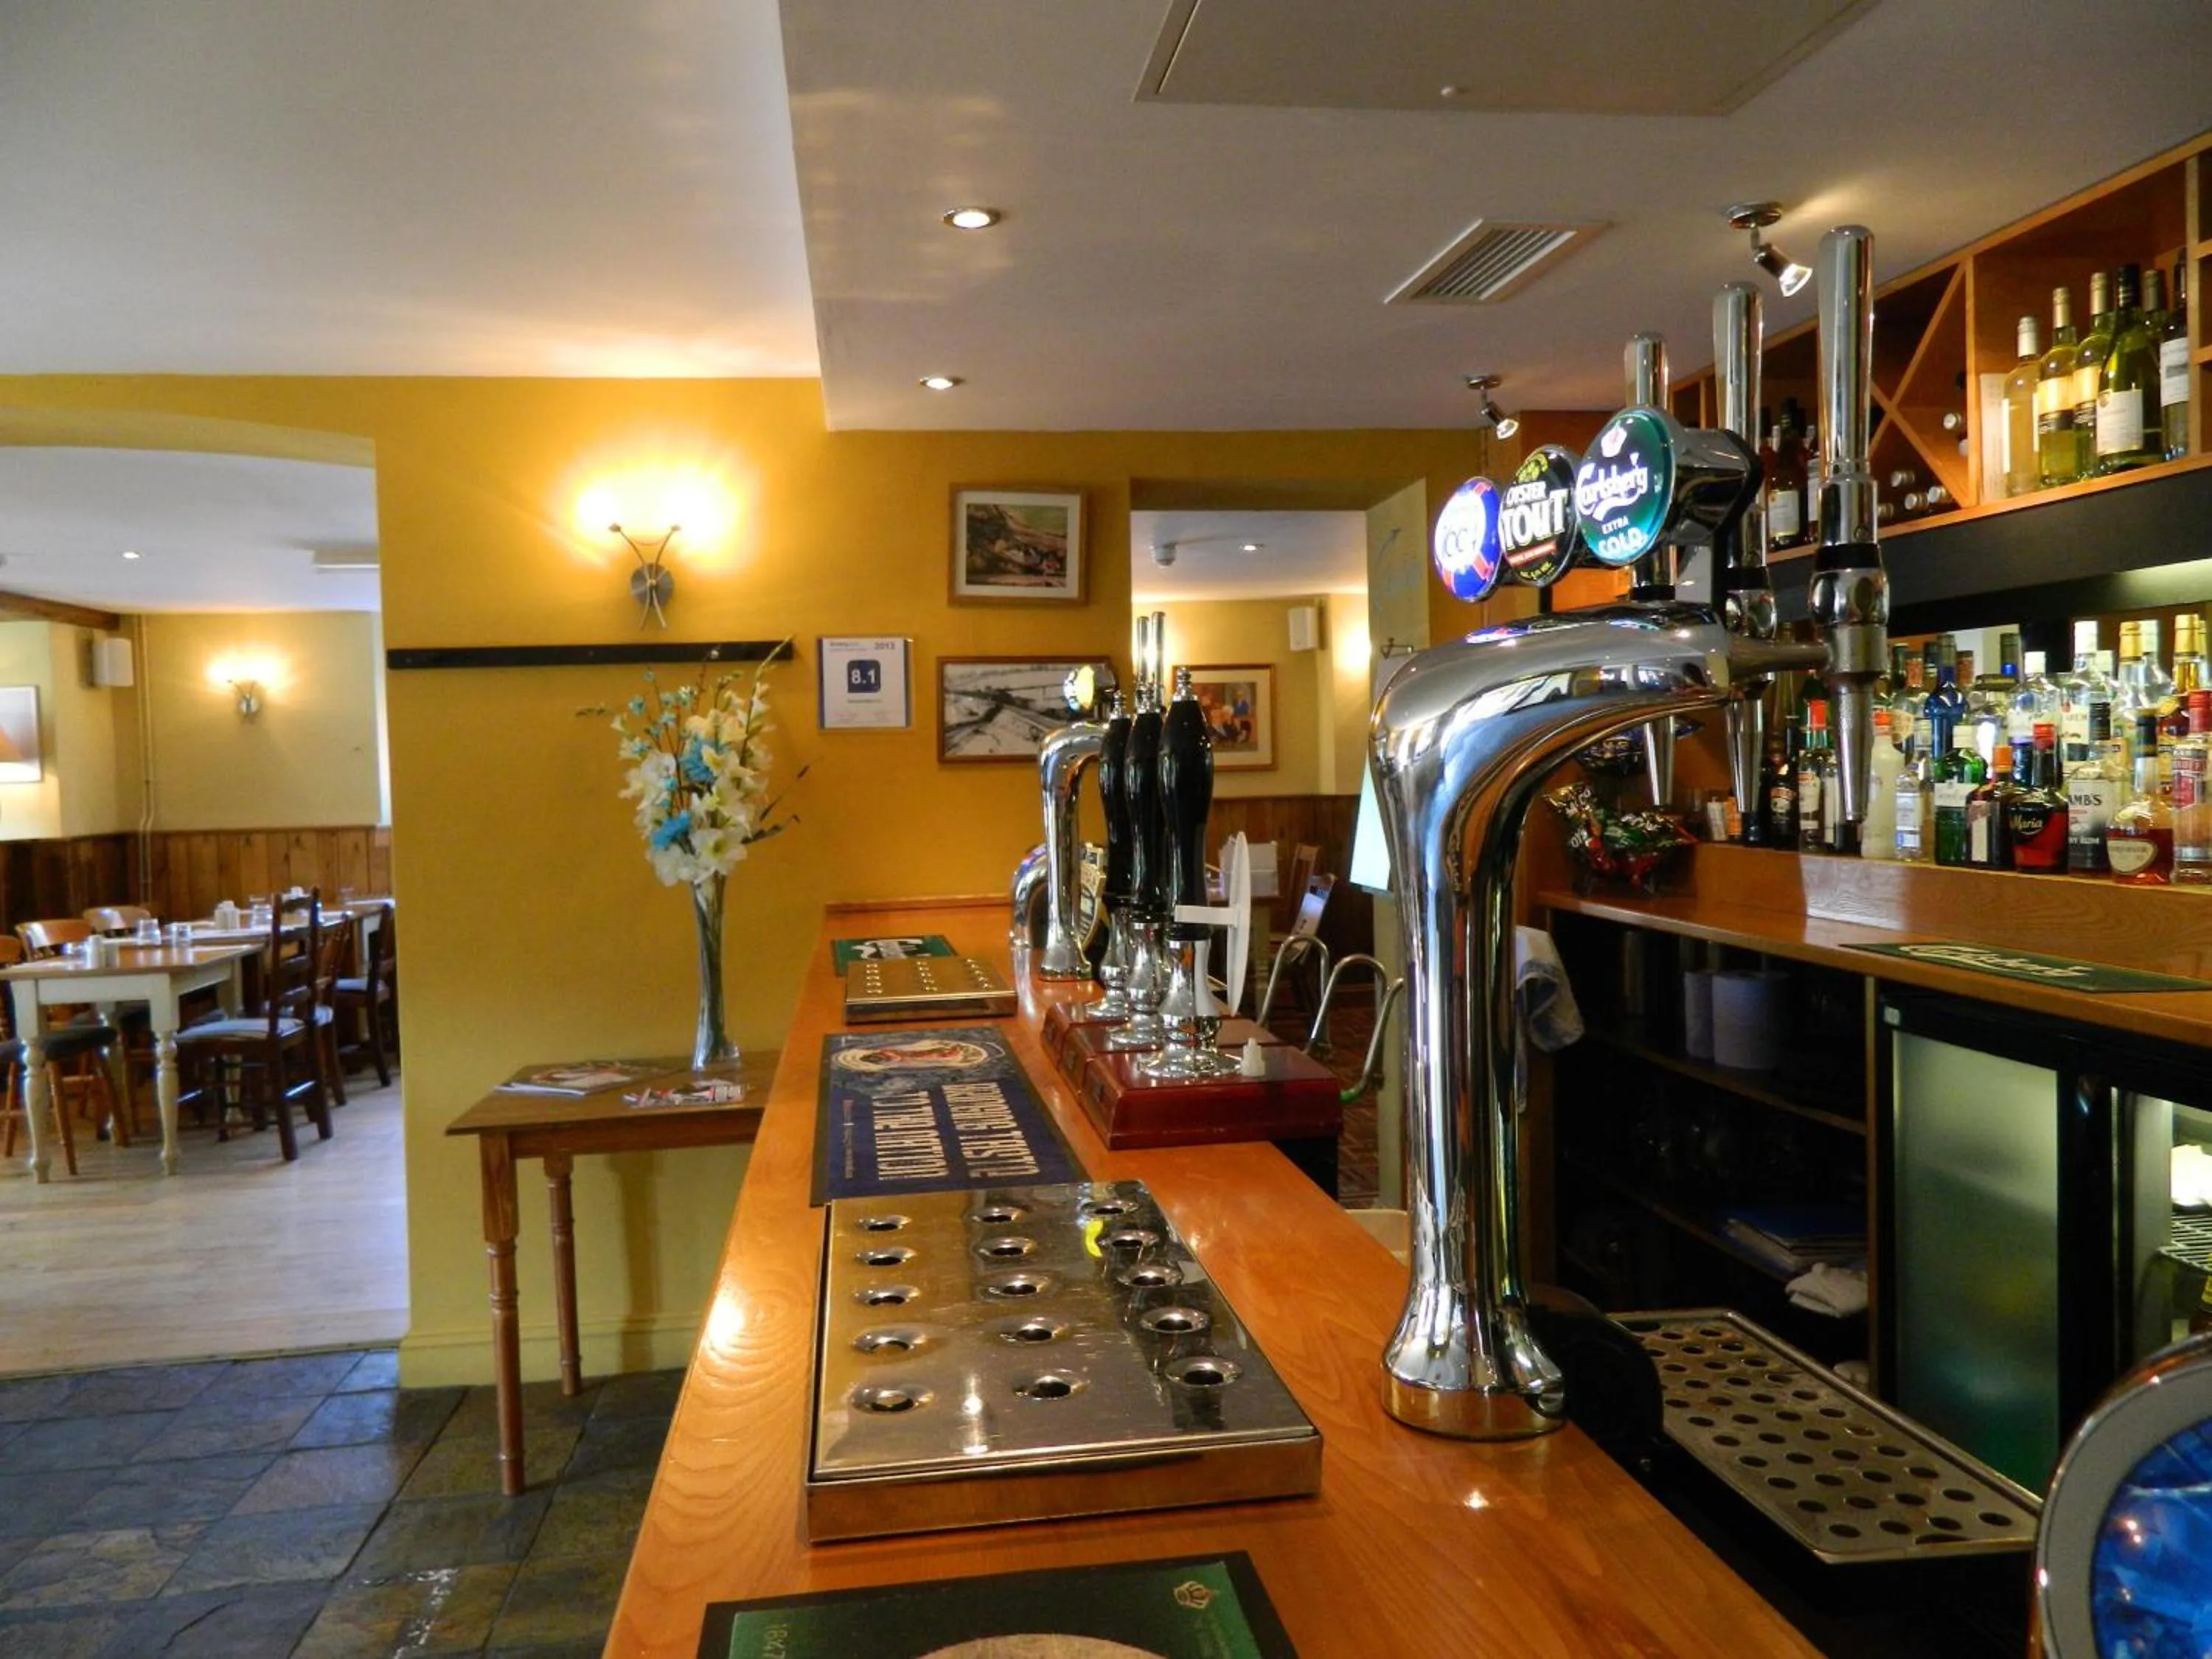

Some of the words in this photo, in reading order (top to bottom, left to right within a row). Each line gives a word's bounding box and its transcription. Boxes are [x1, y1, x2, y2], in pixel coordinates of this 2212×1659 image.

[1576, 460, 1649, 521] Carlsberg
[1601, 516, 1629, 535] EXTRA
[1598, 527, 1644, 555] COLD
[852, 669, 875, 684] 8.1
